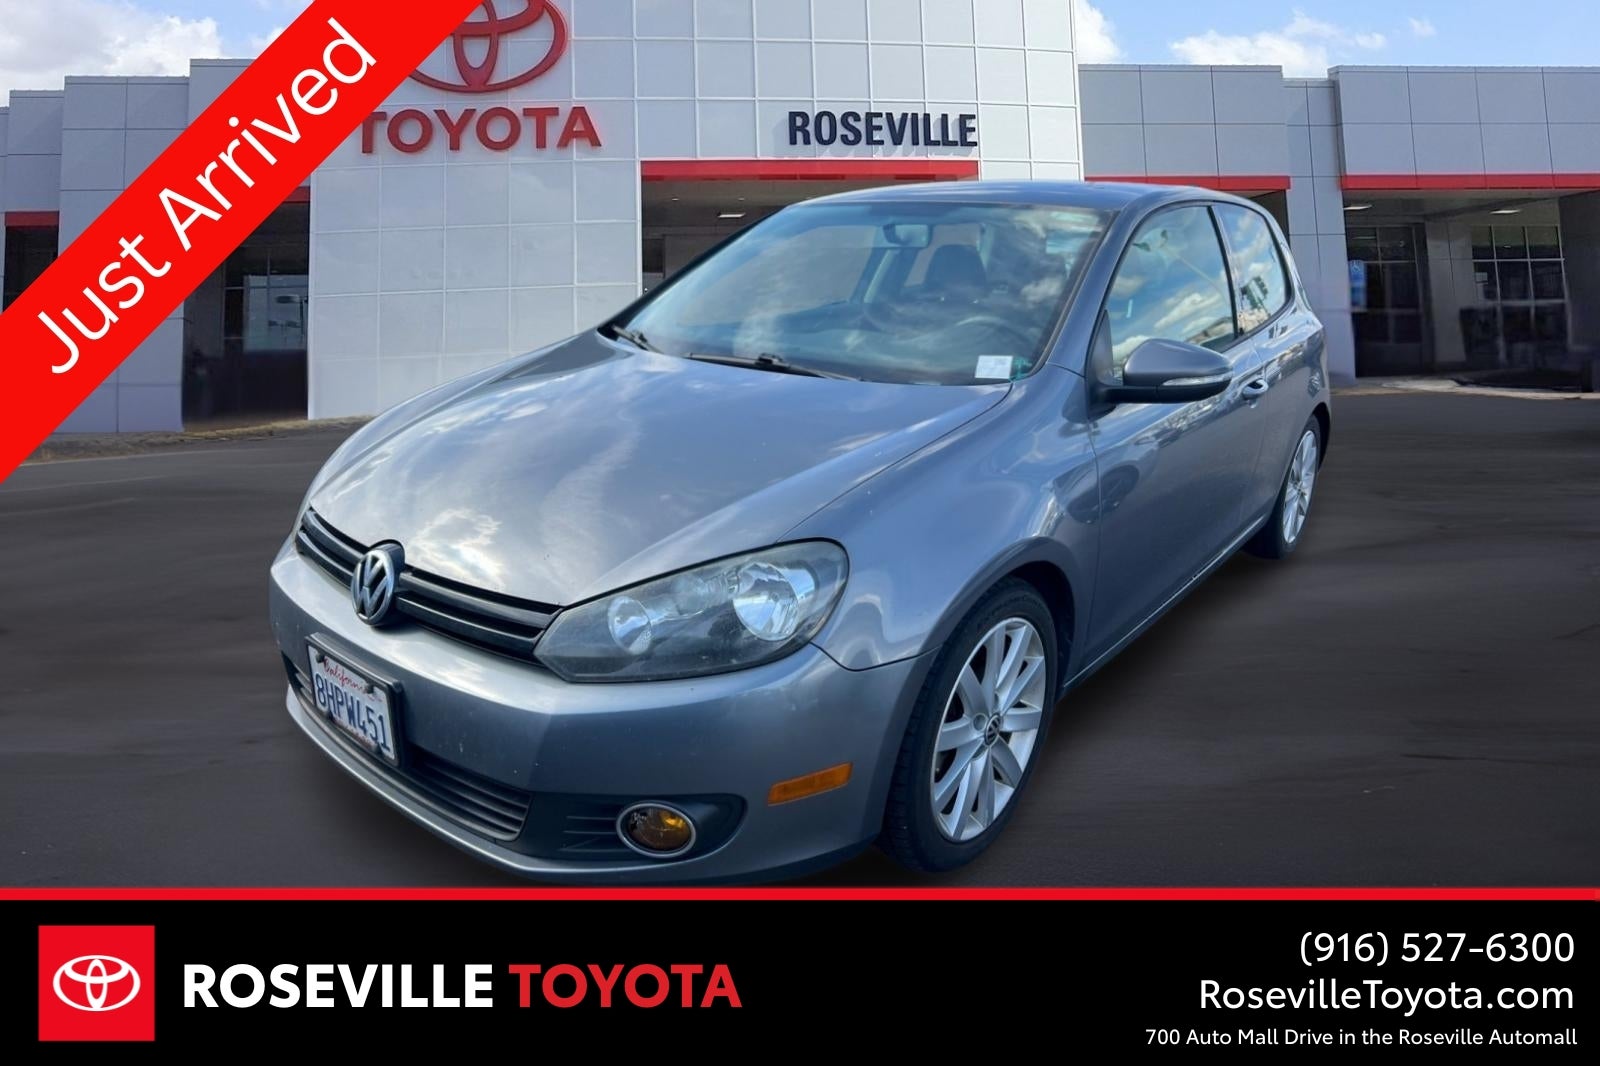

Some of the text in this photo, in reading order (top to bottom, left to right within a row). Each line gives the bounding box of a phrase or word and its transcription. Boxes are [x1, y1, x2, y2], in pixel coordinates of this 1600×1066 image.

[361, 106, 602, 154] TOYOTA
[788, 111, 978, 147] ROSEVILLE
[315, 673, 391, 752] 8HPW451
